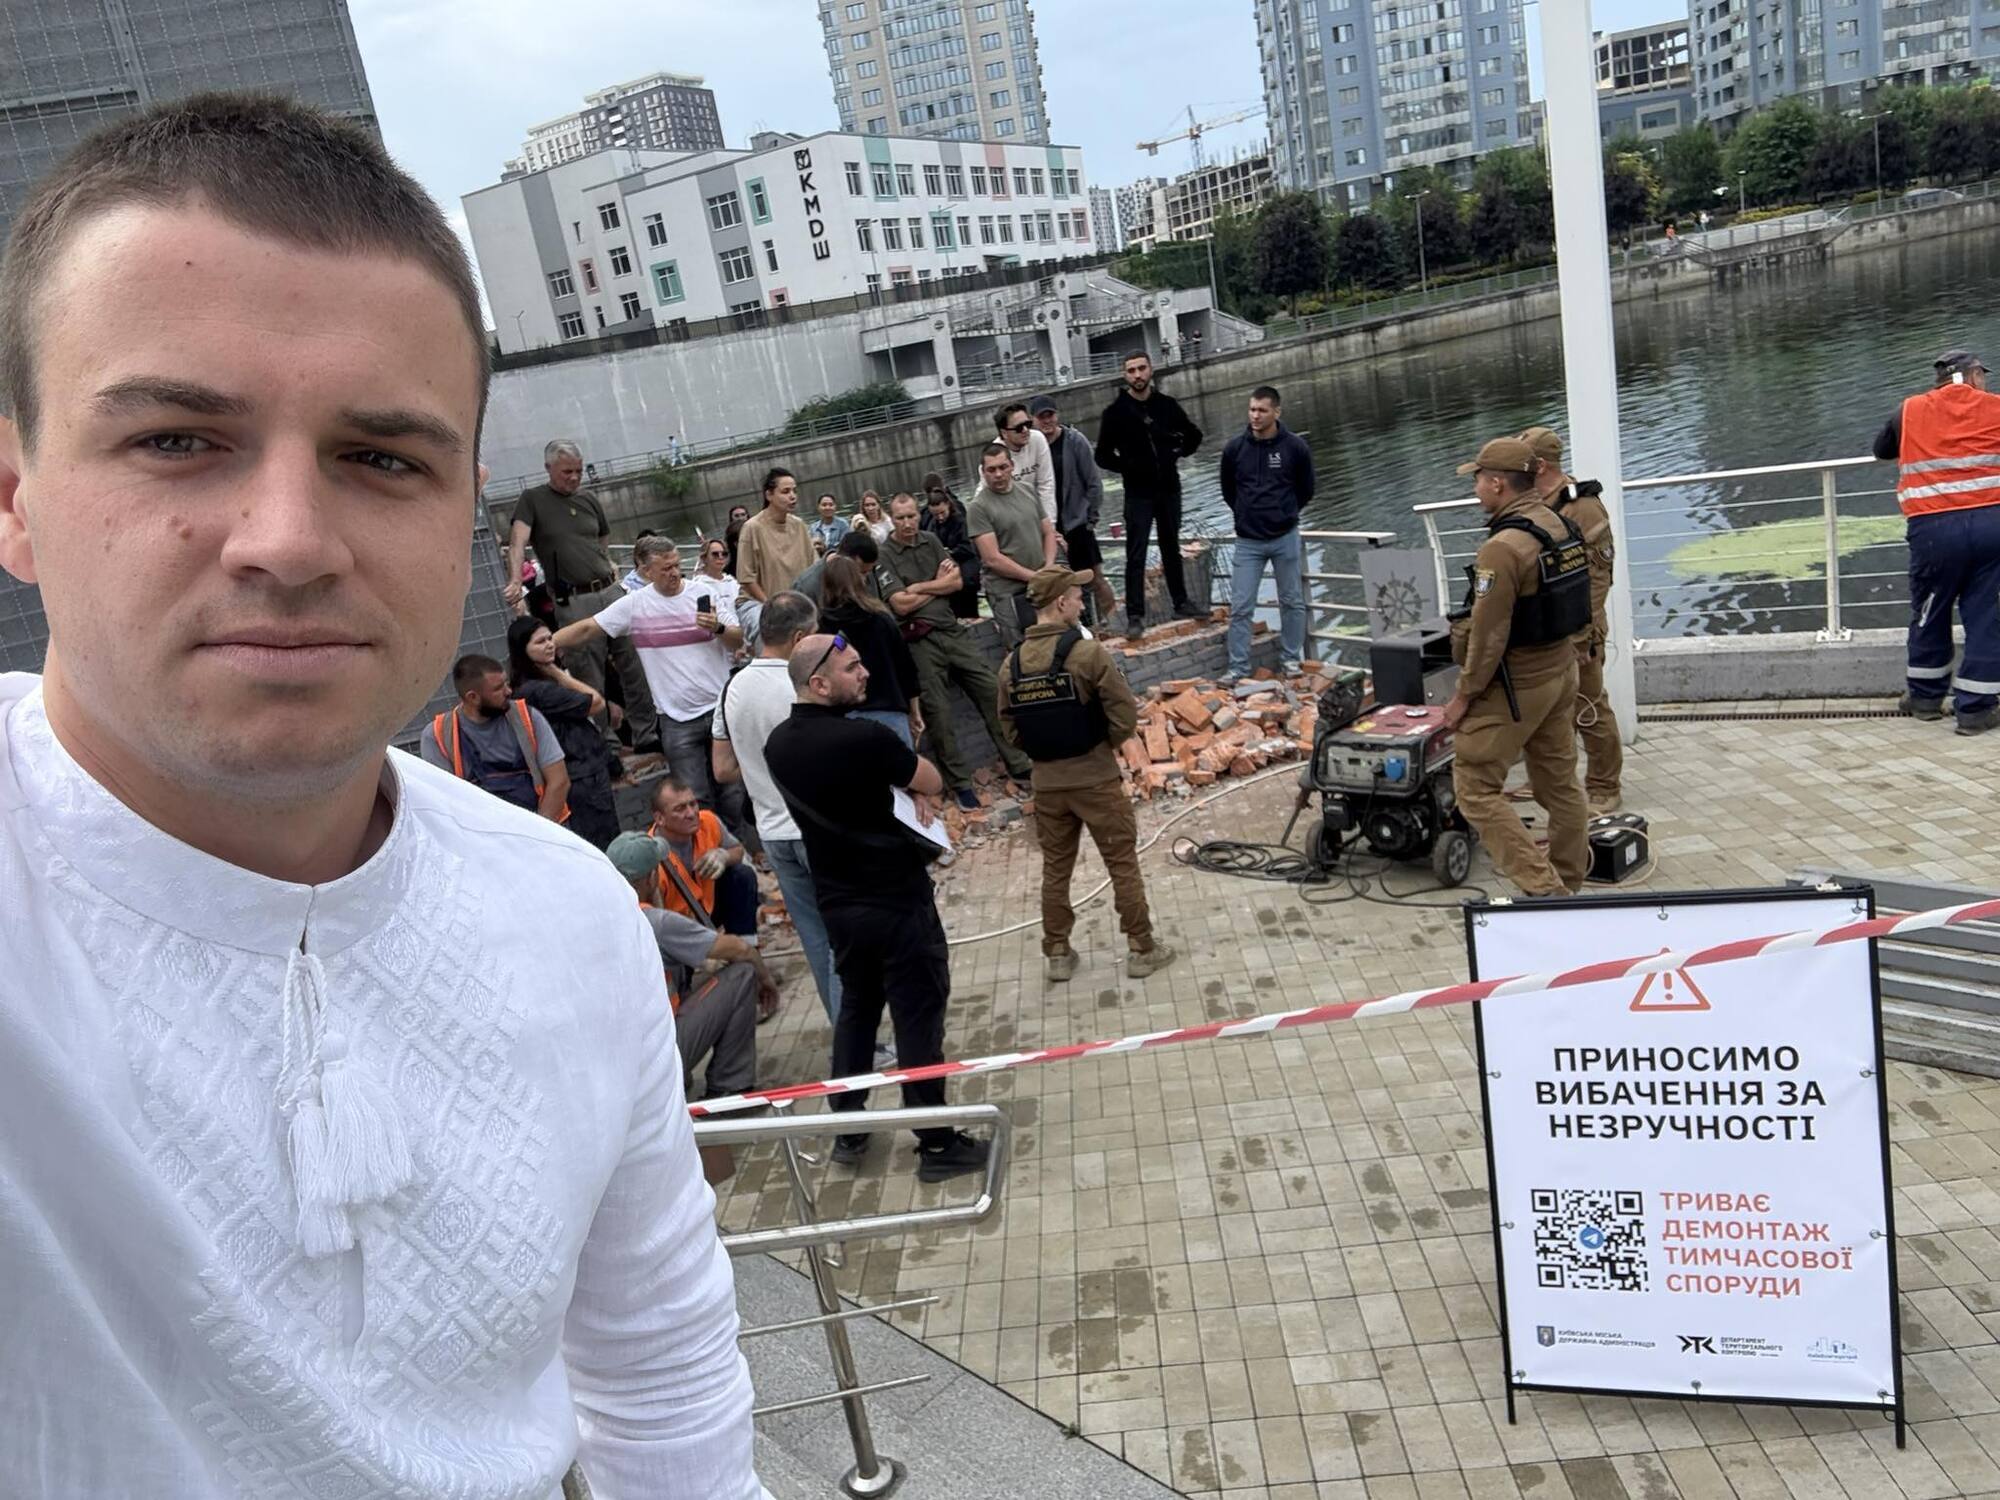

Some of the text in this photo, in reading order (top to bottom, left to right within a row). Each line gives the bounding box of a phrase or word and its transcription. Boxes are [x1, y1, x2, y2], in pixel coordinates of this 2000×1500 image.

[1553, 1046, 1800, 1072] ПРИНОСИМО
[1535, 1080, 1827, 1106] ВИБАЧЕННЯ ЗА
[1549, 1114, 1816, 1141] НЕЗРУЧНОСТІ
[1659, 1191, 1771, 1213] ТРИВАЄ
[1661, 1219, 1830, 1242] ДЕМОНТАЖ
[1663, 1246, 1853, 1270] ТИМЧАСОВОЇ
[1666, 1273, 1801, 1299] СПОРУДИ
